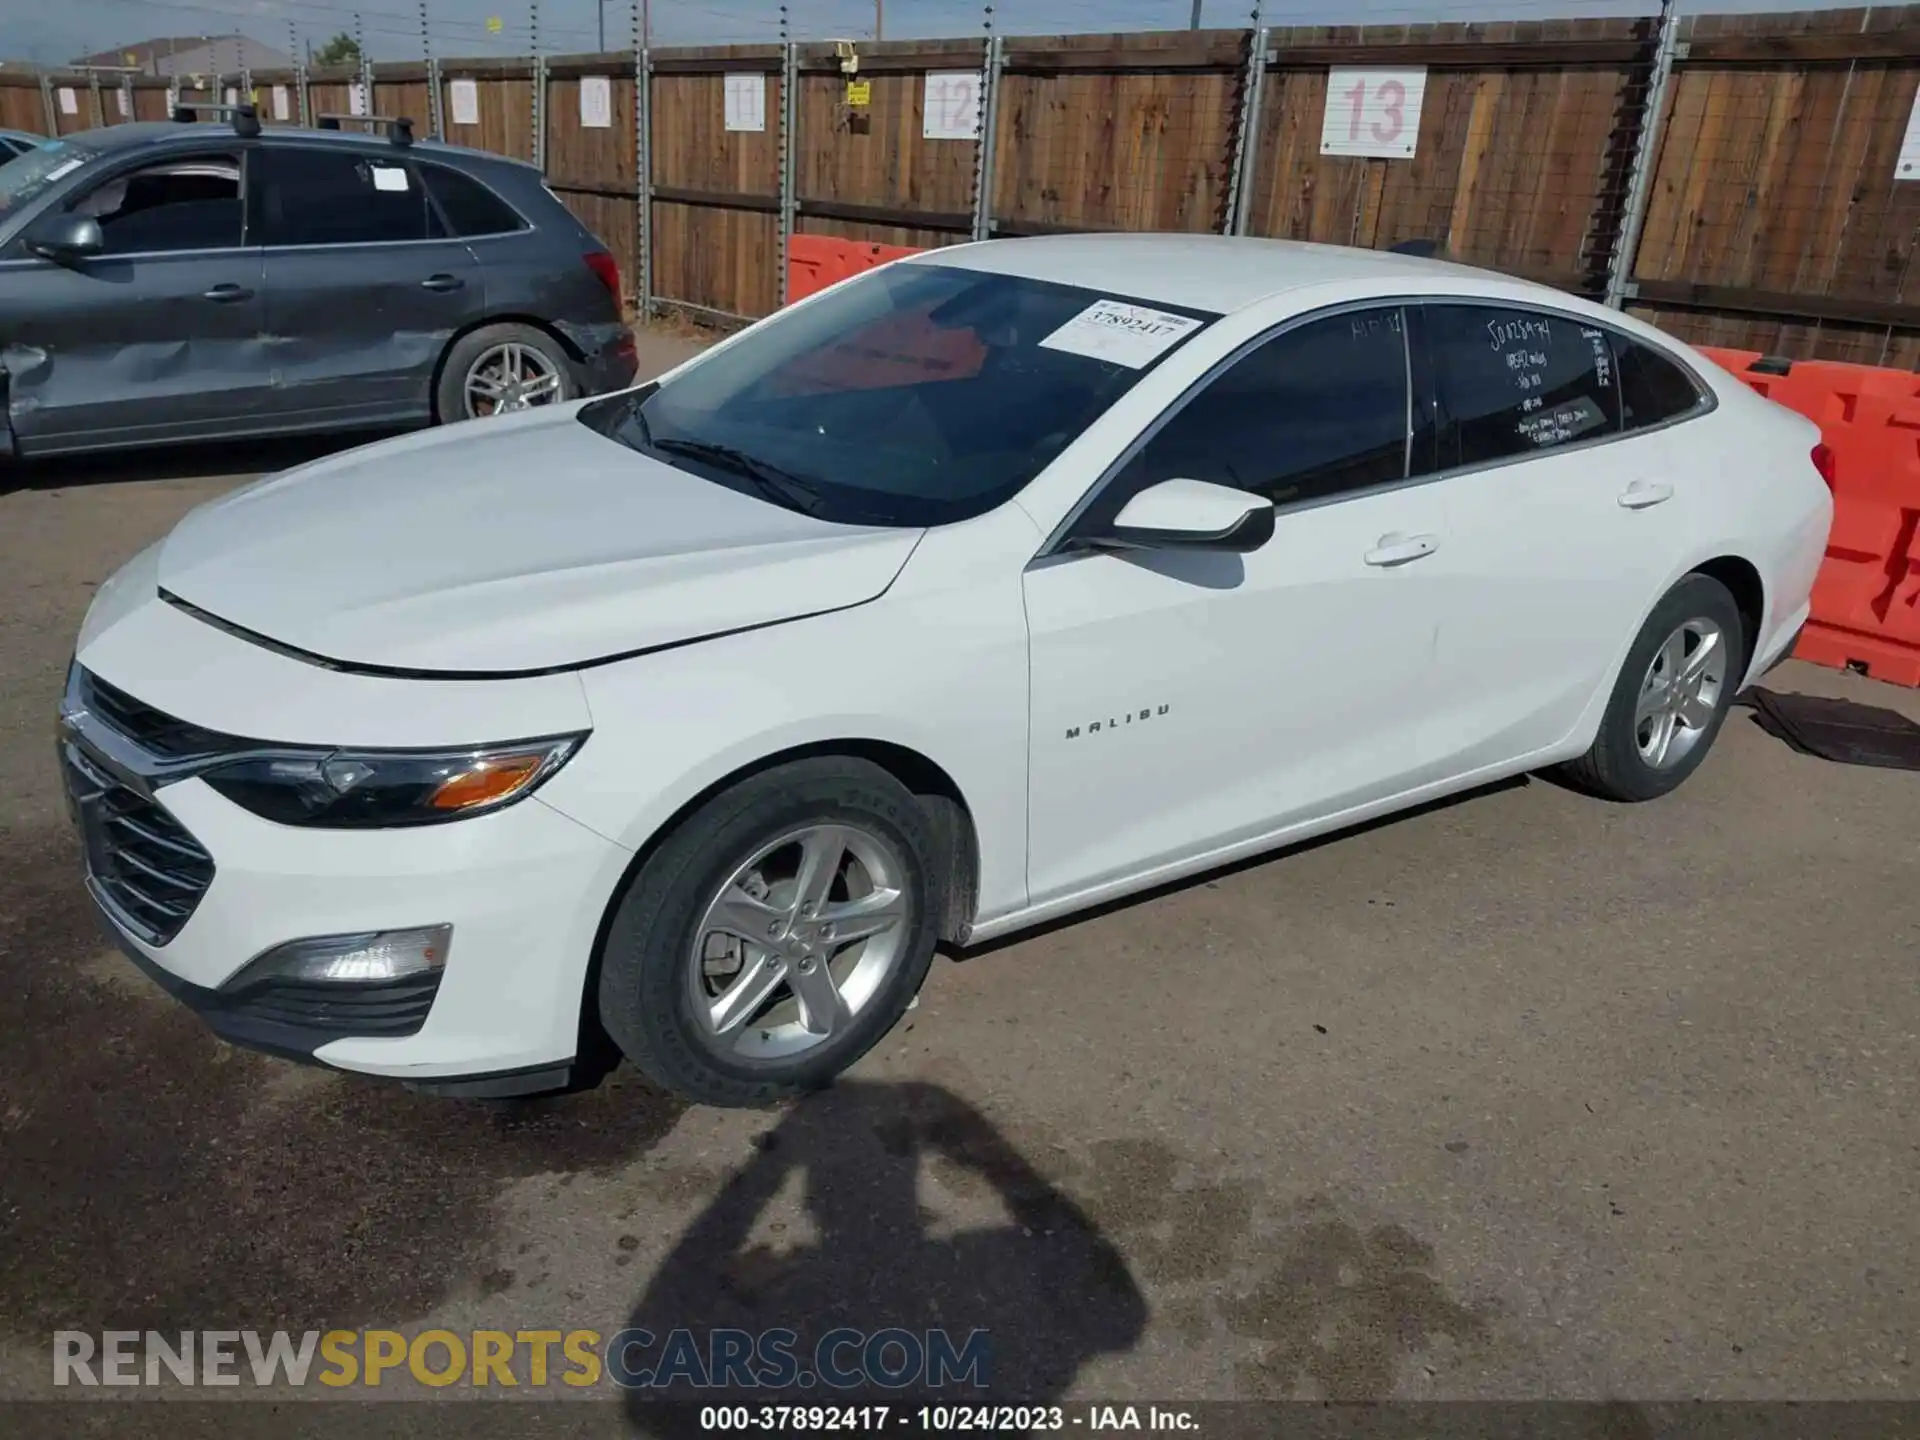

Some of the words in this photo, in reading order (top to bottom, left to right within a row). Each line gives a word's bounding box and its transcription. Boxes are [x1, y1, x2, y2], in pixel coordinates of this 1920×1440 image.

[936, 78, 971, 129] 12
[1341, 77, 1406, 143] 13
[1087, 311, 1176, 337] 37892417
[1065, 703, 1169, 740] MALIBU
